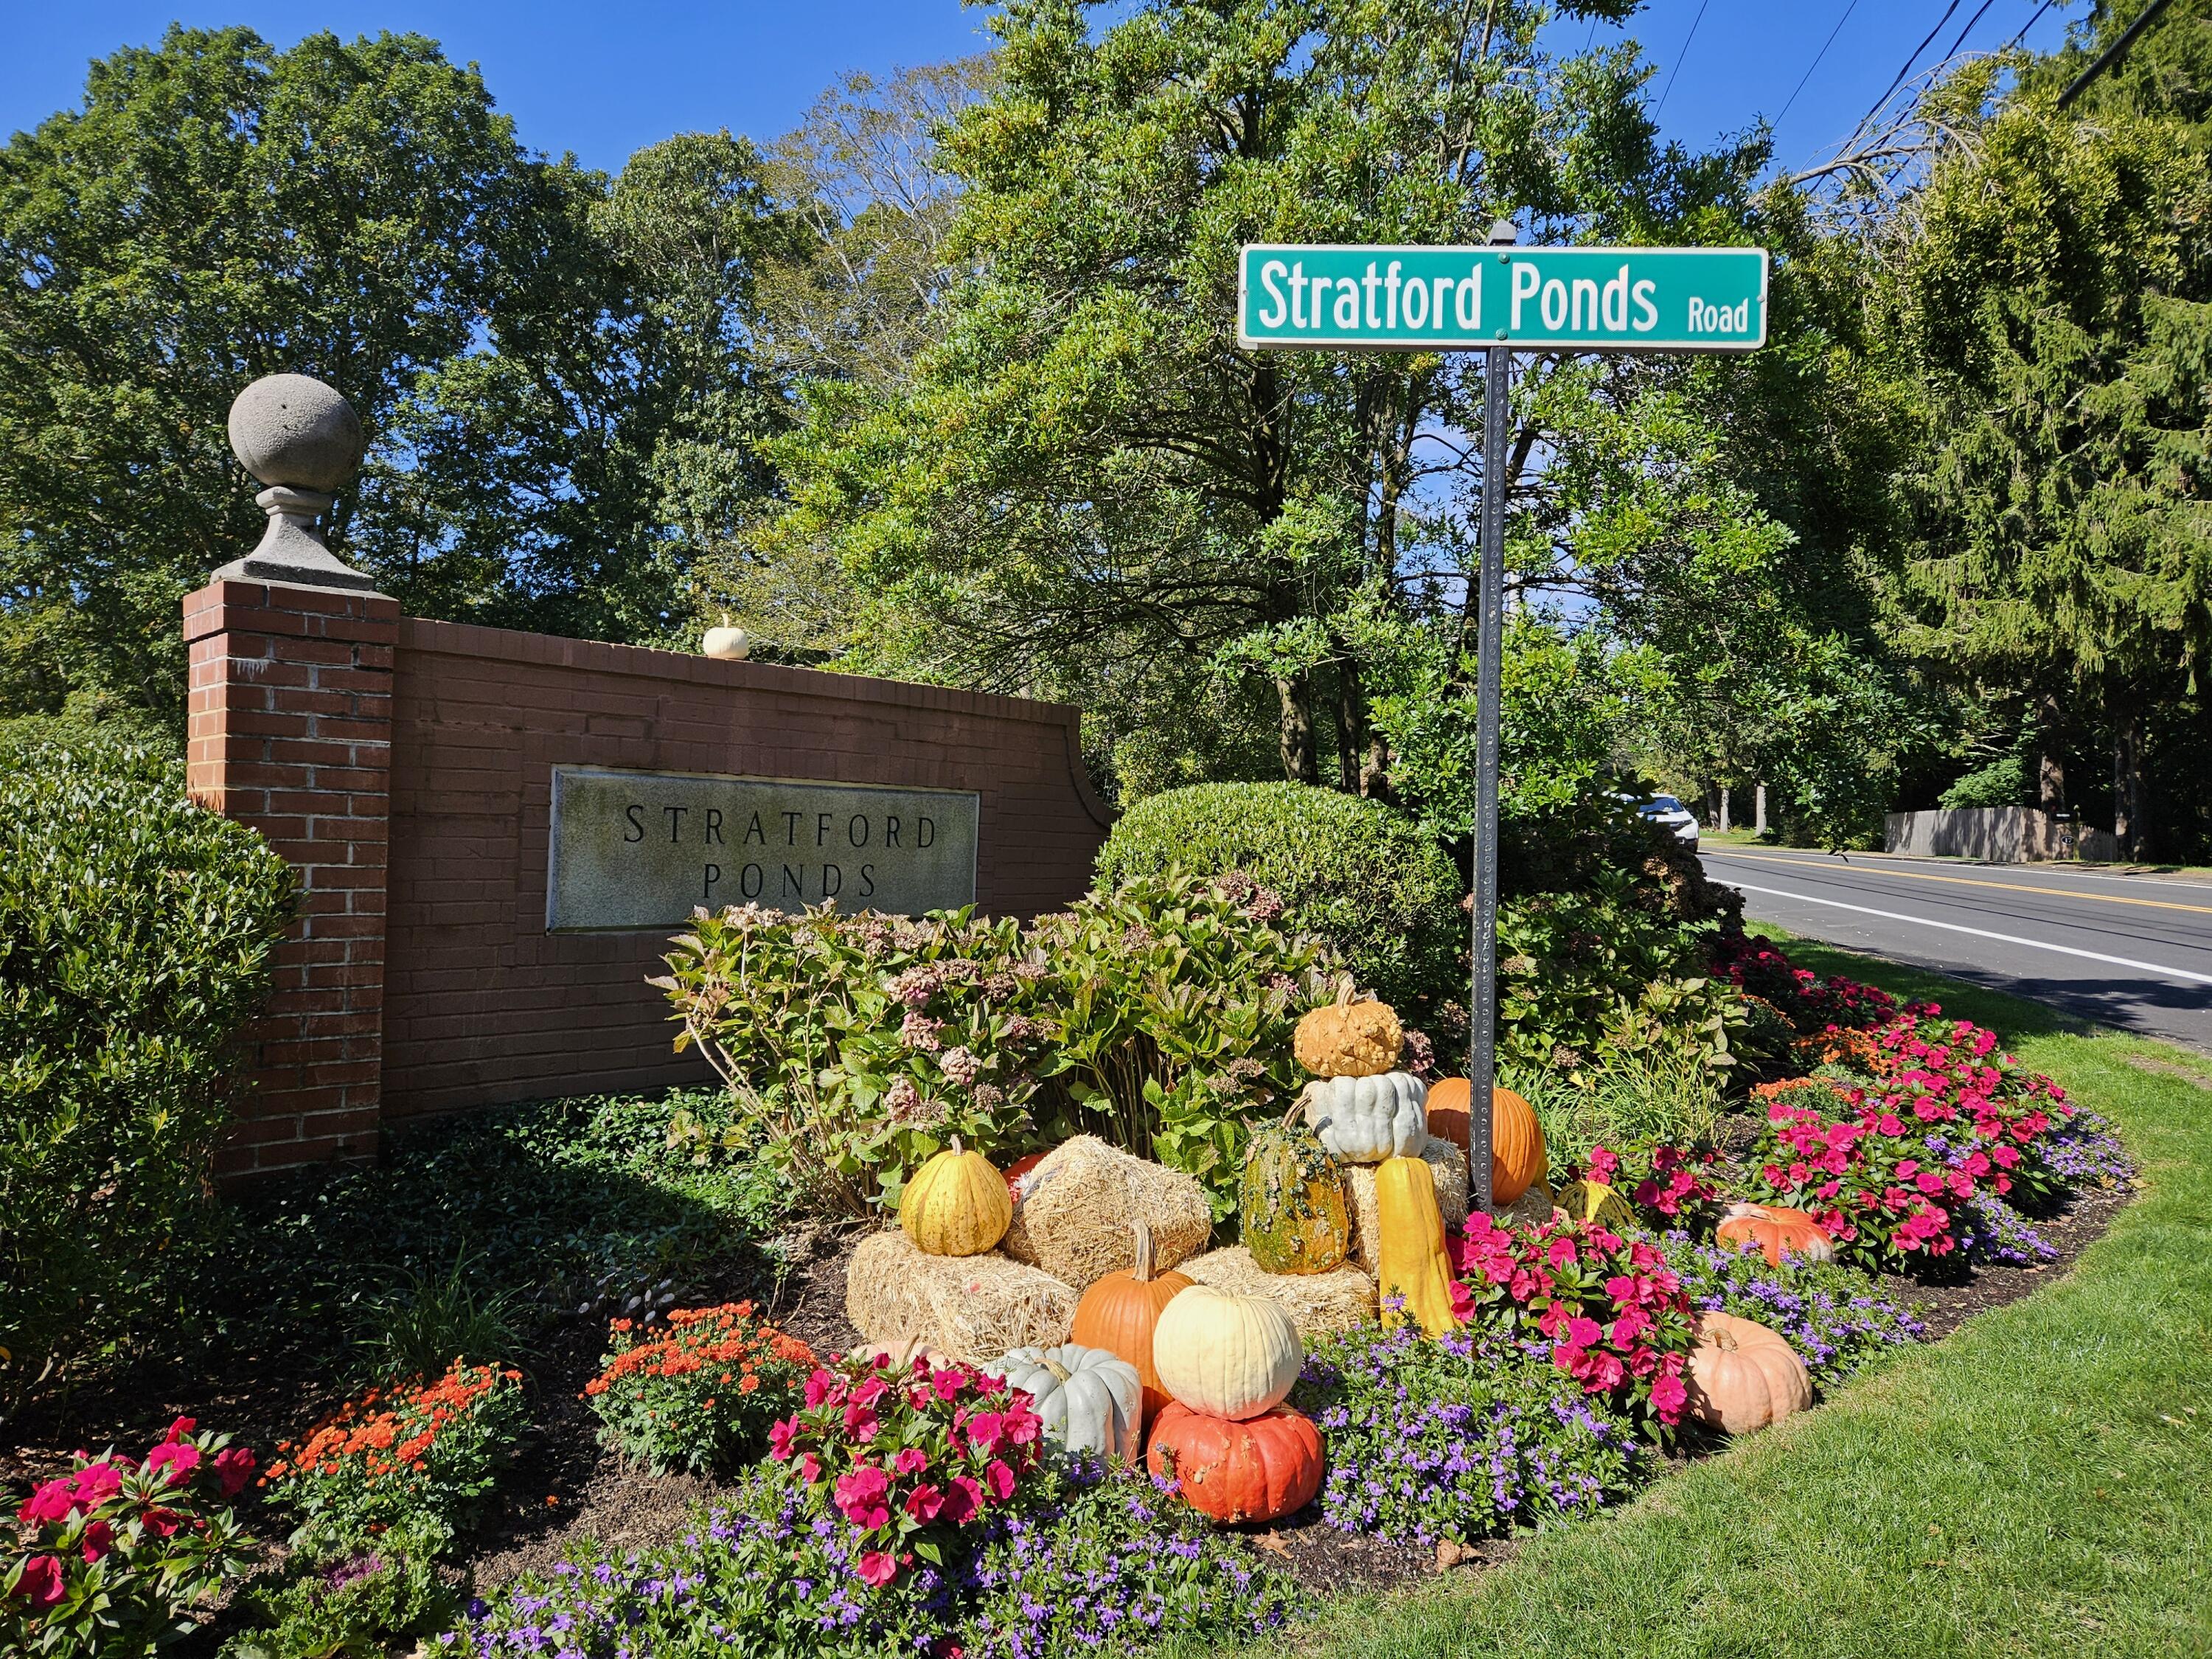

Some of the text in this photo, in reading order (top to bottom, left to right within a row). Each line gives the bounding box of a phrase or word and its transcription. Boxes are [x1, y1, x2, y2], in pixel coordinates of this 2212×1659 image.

[1259, 260, 1748, 332] Stratford Ponds Road
[624, 804, 936, 848] STRATFORD
[703, 863, 875, 898] PONDS
